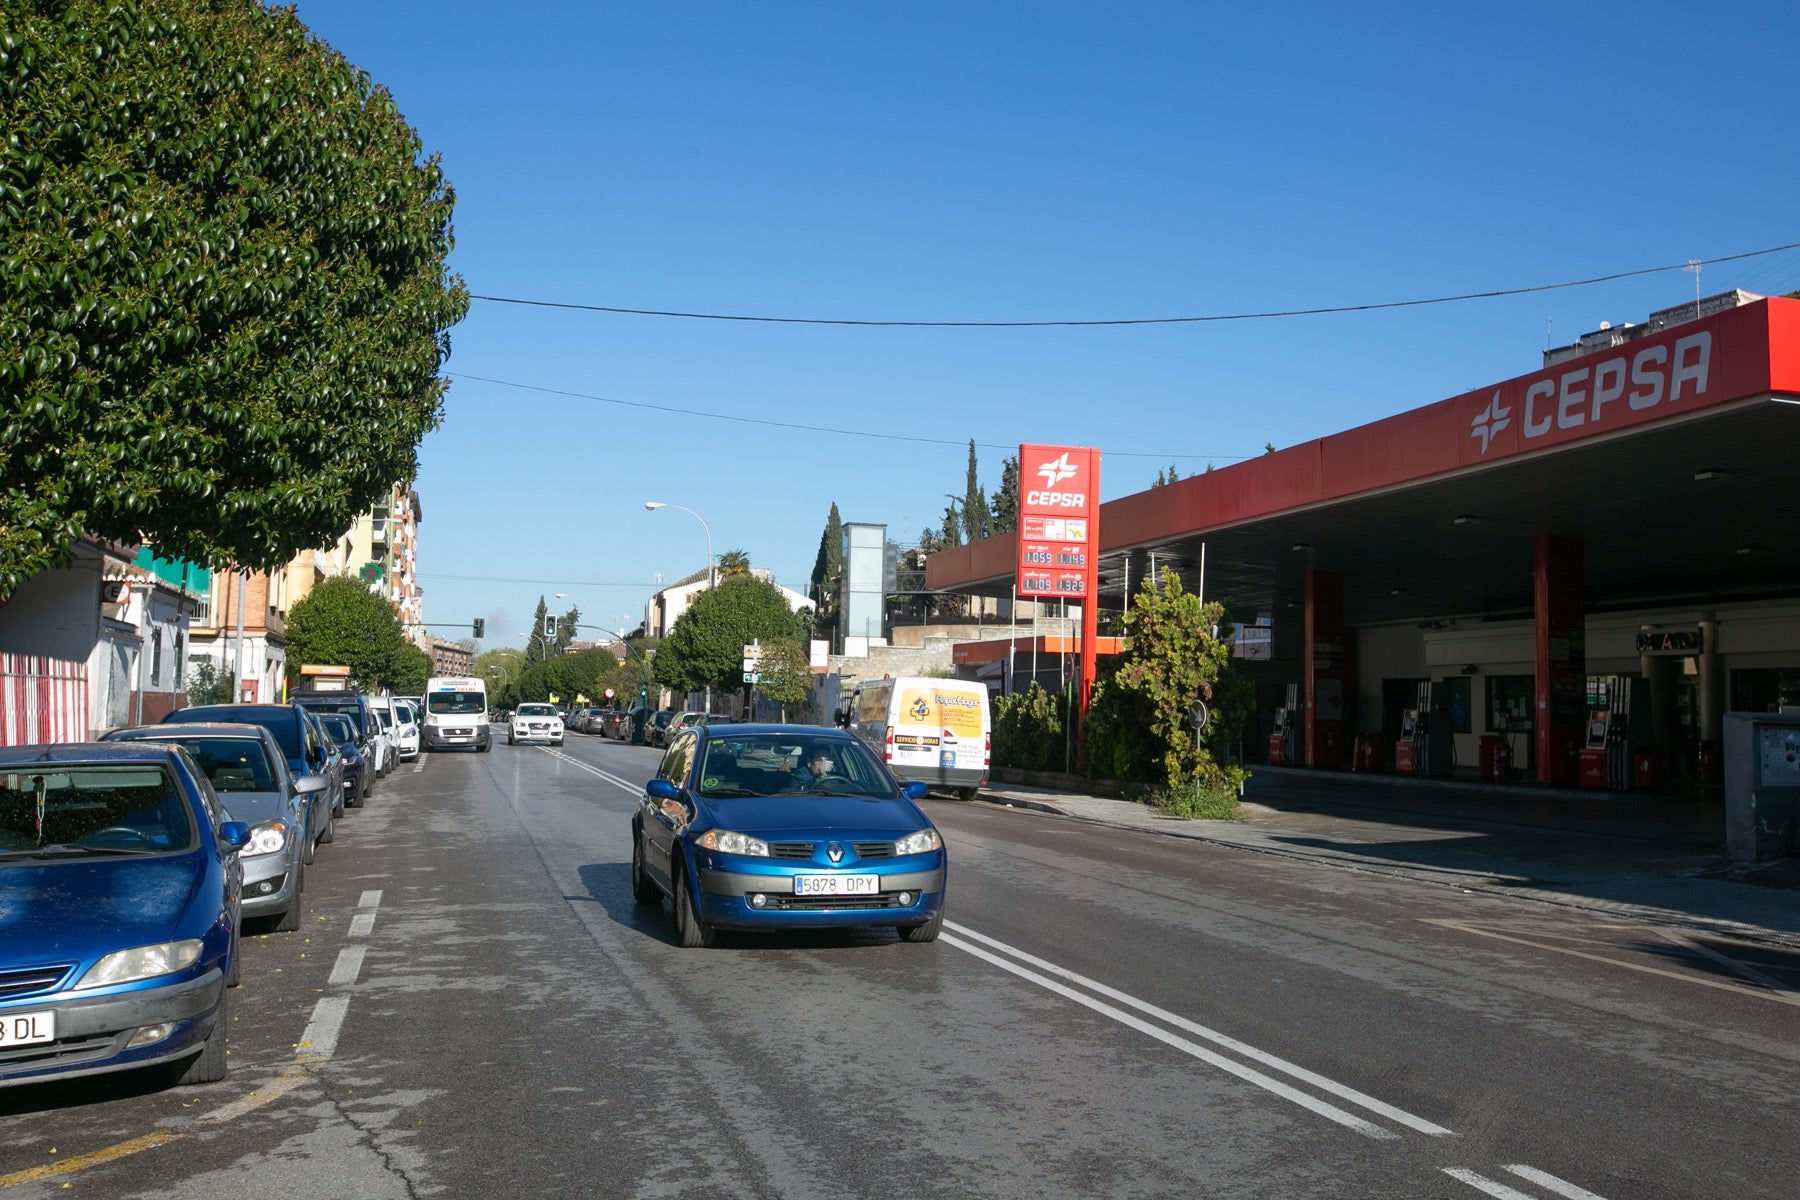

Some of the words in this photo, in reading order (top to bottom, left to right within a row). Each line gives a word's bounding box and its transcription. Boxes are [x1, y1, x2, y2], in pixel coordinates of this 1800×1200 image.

[1523, 331, 1712, 439] CEPSA
[1027, 491, 1085, 508] CEPSA
[803, 878, 836, 892] 5878
[846, 878, 873, 892] DPY
[15, 1017, 46, 1040] DL
